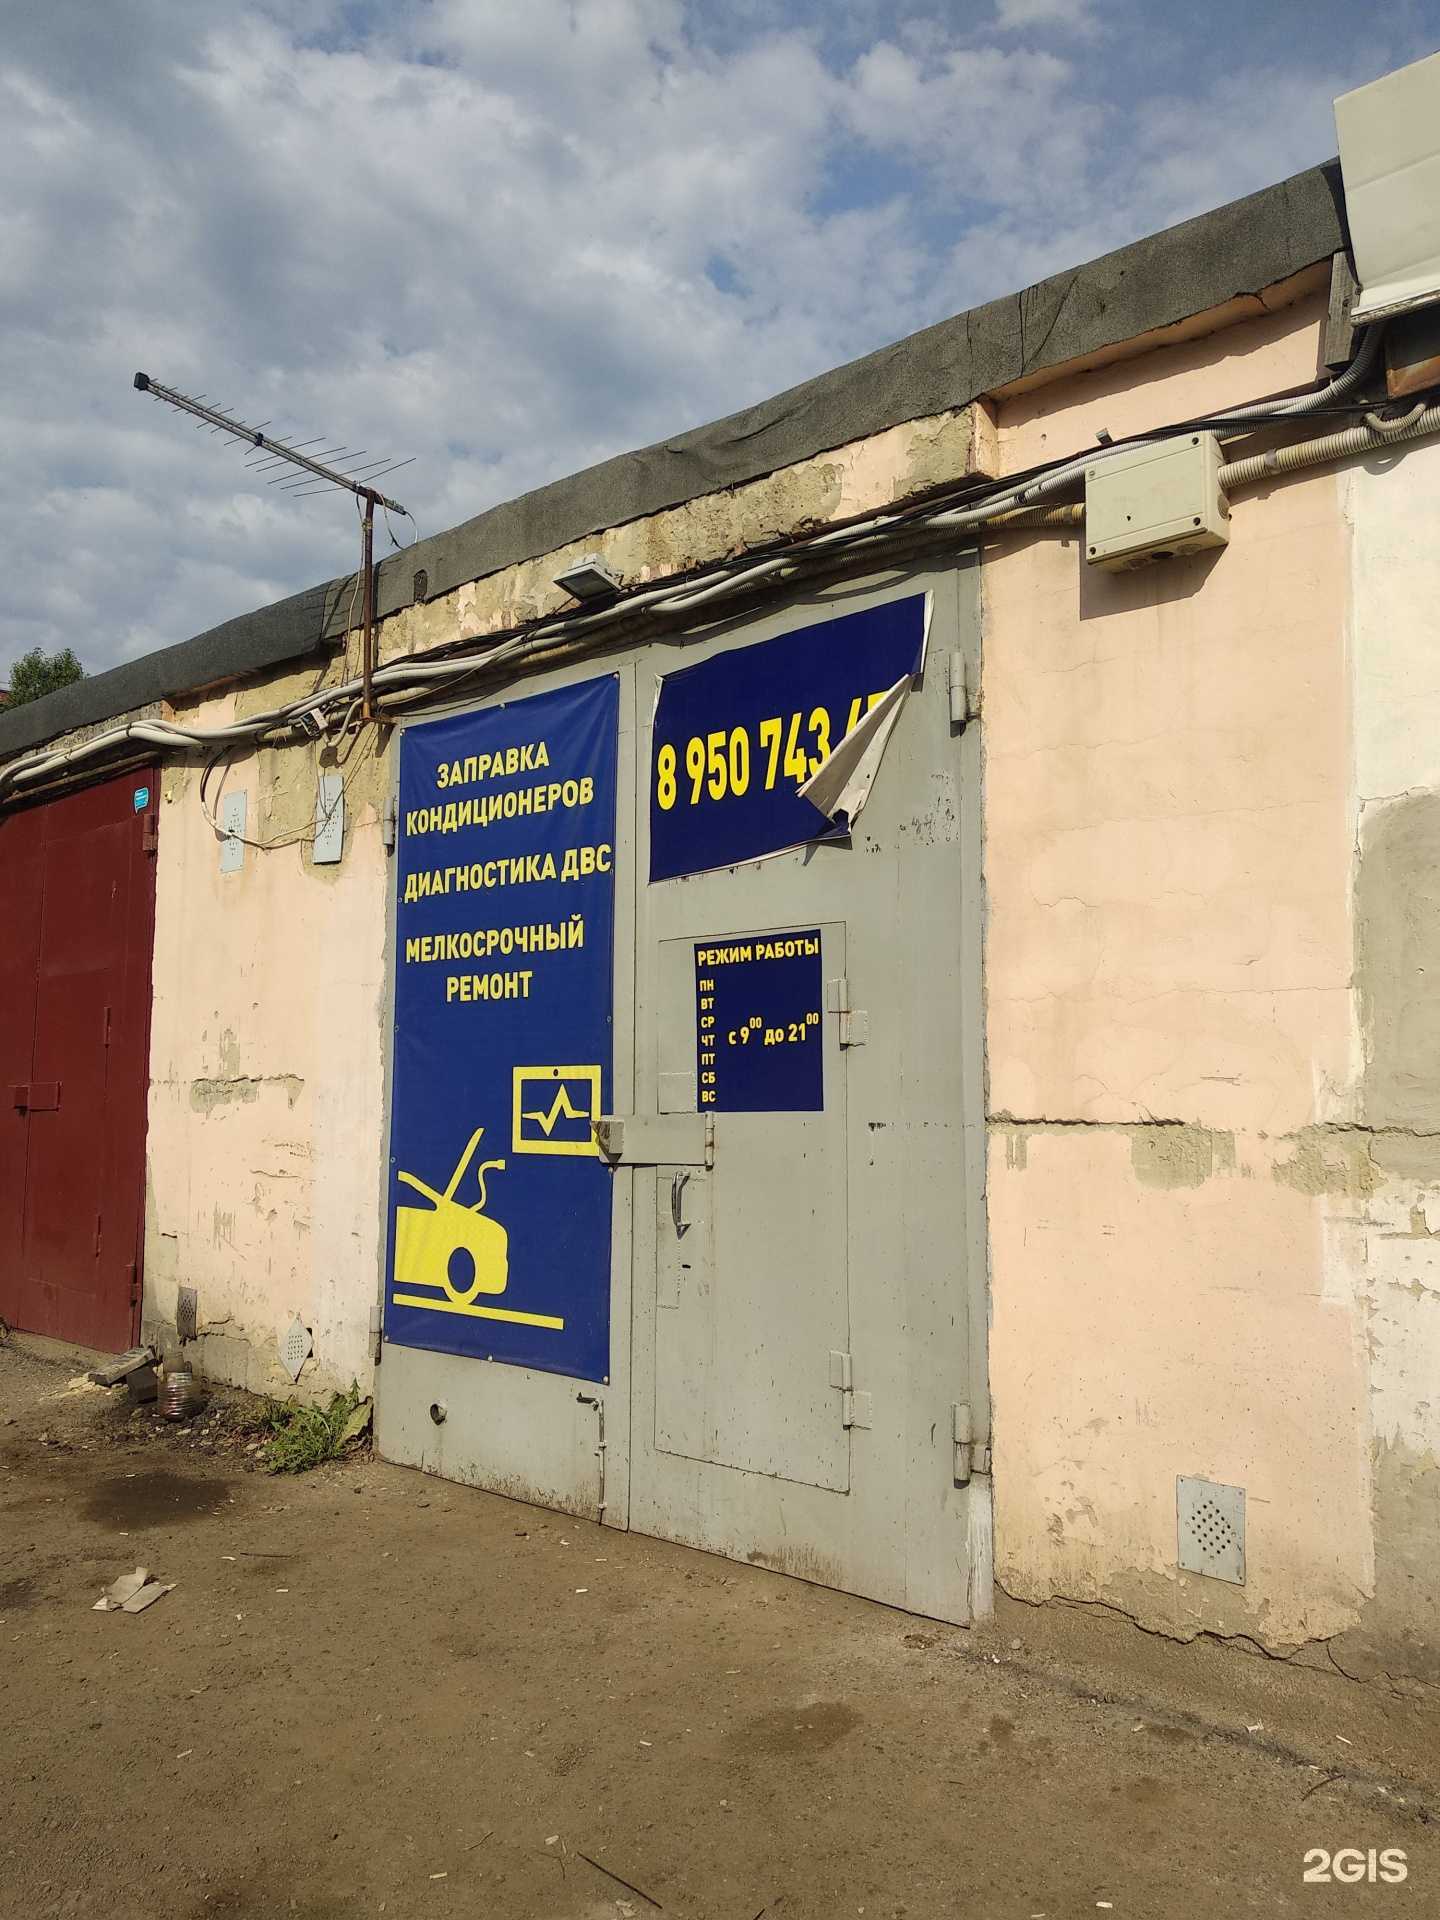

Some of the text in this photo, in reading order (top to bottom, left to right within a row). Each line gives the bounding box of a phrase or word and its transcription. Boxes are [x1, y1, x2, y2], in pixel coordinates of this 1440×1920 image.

[435, 741, 551, 789] ЗАПРАВКА
[656, 744, 677, 811] 8
[685, 725, 750, 805] 950
[759, 705, 832, 791] 743
[405, 776, 595, 837] КОНДИЦИОНЕРОВ
[404, 843, 612, 904] ДИАГНОСТИКА ДВС
[405, 913, 585, 964] МЕЛКОСРОЧНЫЙ
[697, 937, 819, 967] РЕЖИМ РАБОТЫ
[446, 970, 533, 1003] РЕМОНТ
[699, 979, 715, 992] ПН
[700, 997, 715, 1010] ВТ
[700, 1015, 715, 1029] СР
[701, 1034, 716, 1047] ЧТ
[763, 1028, 785, 1046] до
[701, 1053, 716, 1065] ПТ
[701, 1071, 716, 1084] СБ
[701, 1090, 717, 1103] ВС
